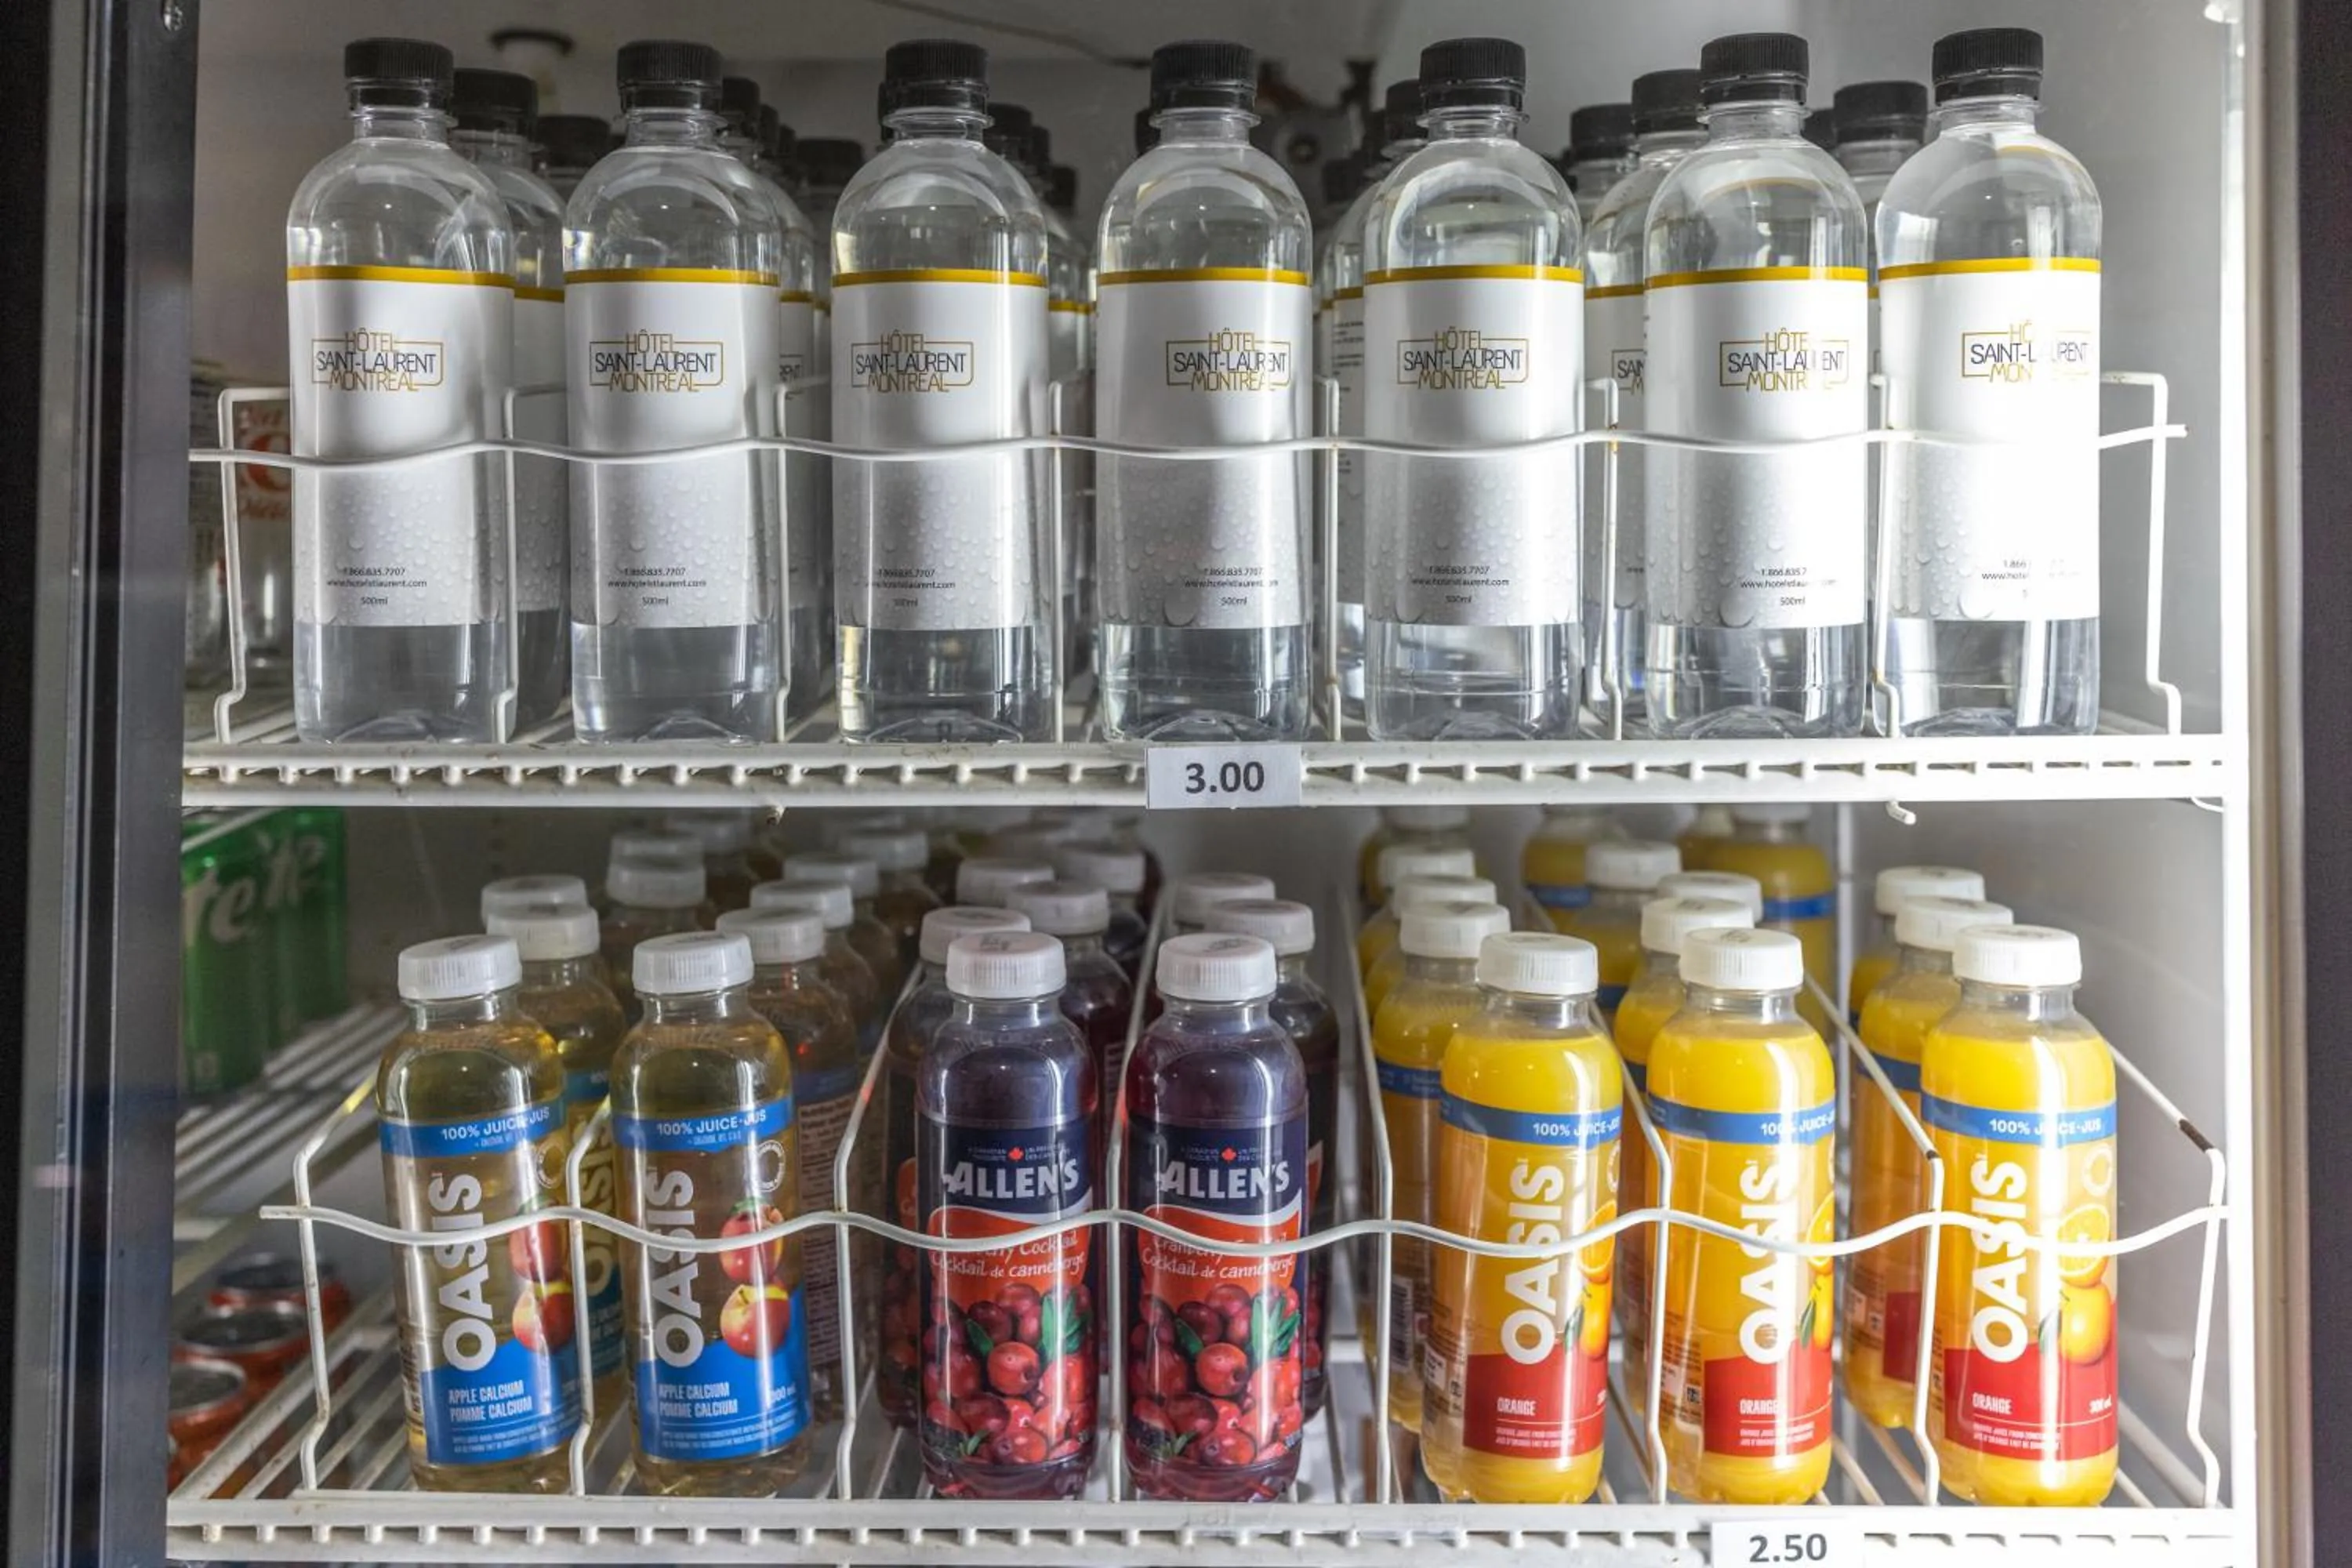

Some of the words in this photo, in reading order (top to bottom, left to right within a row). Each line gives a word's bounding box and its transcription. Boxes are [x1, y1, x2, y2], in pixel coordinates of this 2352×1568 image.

[626, 329, 679, 354] HÔTEL
[880, 329, 931, 354] HÔTEL
[1435, 326, 1486, 350] HÔTEL
[1765, 328, 1809, 353] HÔTE
[1185, 761, 1265, 794] 3.00
[441, 1123, 481, 1141] 100%
[656, 1122, 694, 1136] 100%
[1533, 1122, 1570, 1137] 100%
[1989, 1118, 2031, 1135] 100%
[942, 1159, 1080, 1199] ALLENS
[428, 1173, 496, 1371] OASIS
[645, 1168, 705, 1367] OASIS
[991, 1265, 1004, 1278] de
[1200, 1265, 1214, 1278] de
[1501, 1163, 1564, 1365] OASIS
[1740, 1163, 1796, 1365] OASIS
[1970, 1160, 2029, 1363] OASIS
[448, 1387, 477, 1403] APPLE
[479, 1380, 524, 1402] CALCIUM
[658, 1382, 684, 1399] APPLE
[488, 1396, 532, 1418] CALCIUM
[695, 1399, 738, 1417] CALCIUM
[1497, 1396, 1537, 1416] ORANGE
[1973, 1392, 2013, 1415] ORANGE
[1749, 1533, 1828, 1563] 2.50
